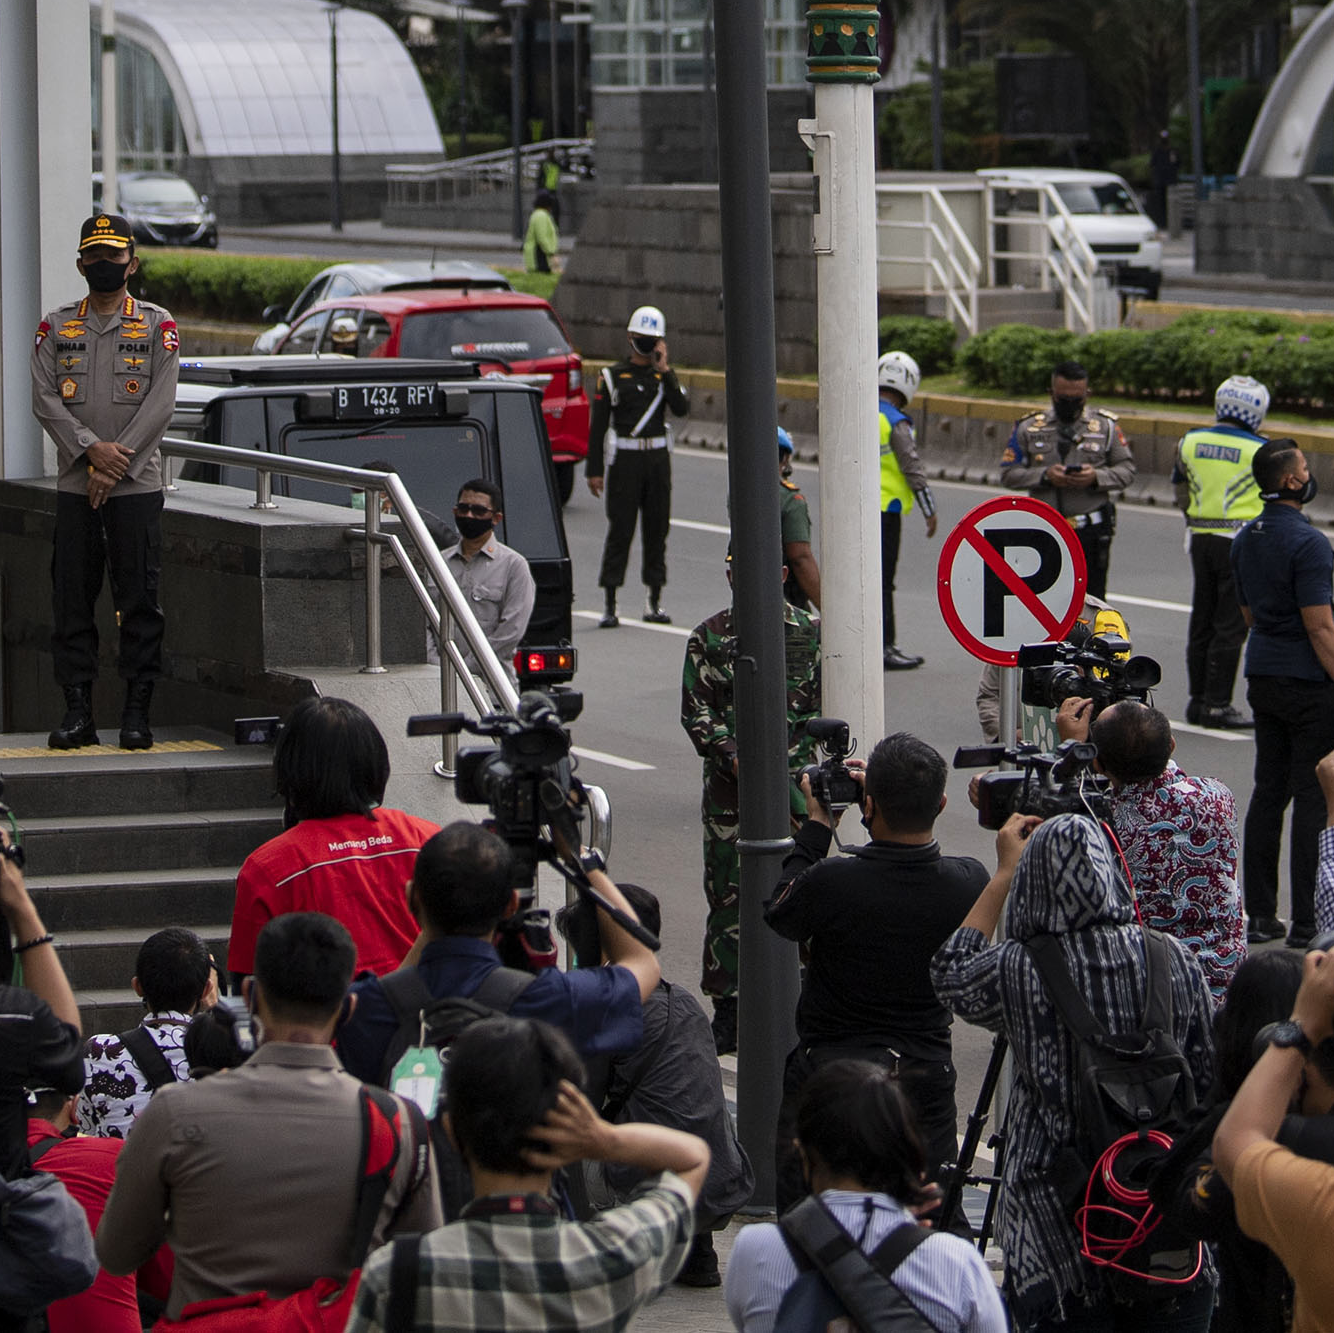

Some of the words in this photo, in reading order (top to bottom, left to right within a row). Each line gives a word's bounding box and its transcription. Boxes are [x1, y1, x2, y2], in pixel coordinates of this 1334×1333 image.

[641, 316, 658, 328] PM
[119, 344, 149, 353] POLRI
[338, 389, 349, 408] B
[362, 387, 398, 407] 1434
[407, 385, 435, 406] RFY
[1224, 388, 1254, 404] POLISI
[1197, 444, 1240, 463] POLISI
[983, 528, 1062, 638] P
[368, 835, 393, 846] Beda
